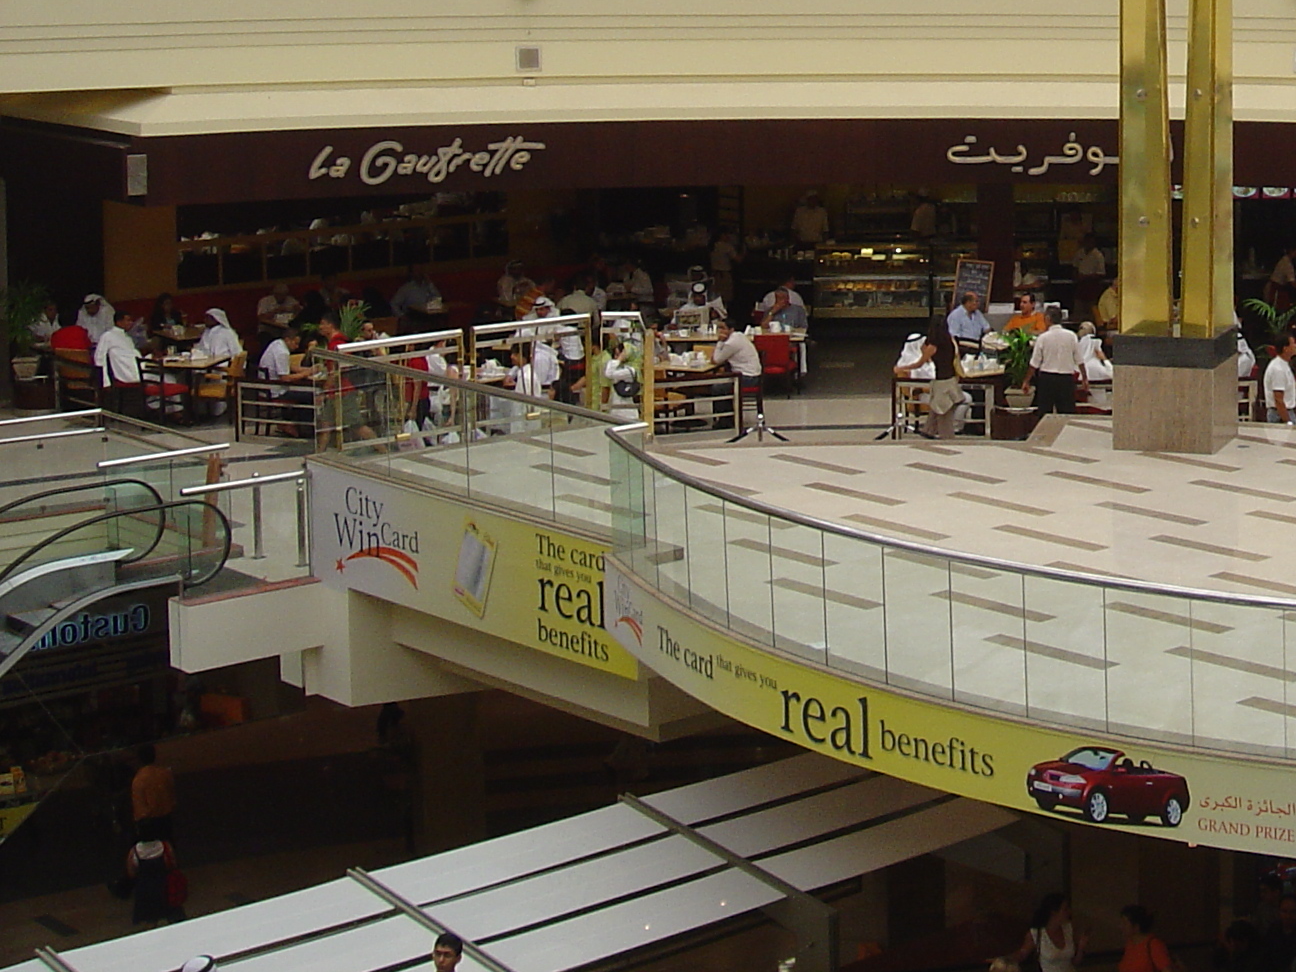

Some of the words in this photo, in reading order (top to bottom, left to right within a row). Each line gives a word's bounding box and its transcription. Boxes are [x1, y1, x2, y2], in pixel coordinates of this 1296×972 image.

[308, 145, 351, 180] La
[345, 486, 384, 527] City
[535, 533, 565, 561] The
[570, 547, 607, 573] card
[535, 558, 551, 572] that
[553, 564, 575, 579] gives
[576, 572, 592, 585] you
[537, 577, 606, 630] real
[537, 617, 610, 662] benefits
[657, 625, 681, 661] The
[683, 645, 714, 680] card
[716, 653, 733, 673] that
[734, 664, 758, 684] gives
[759, 673, 778, 690] you
[780, 689, 874, 760] real
[879, 719, 995, 778] benefits
[1246, 797, 1296, 820] الجائزة
[1197, 817, 1251, 837] GRAND
[1255, 824, 1296, 843] PRIZE
